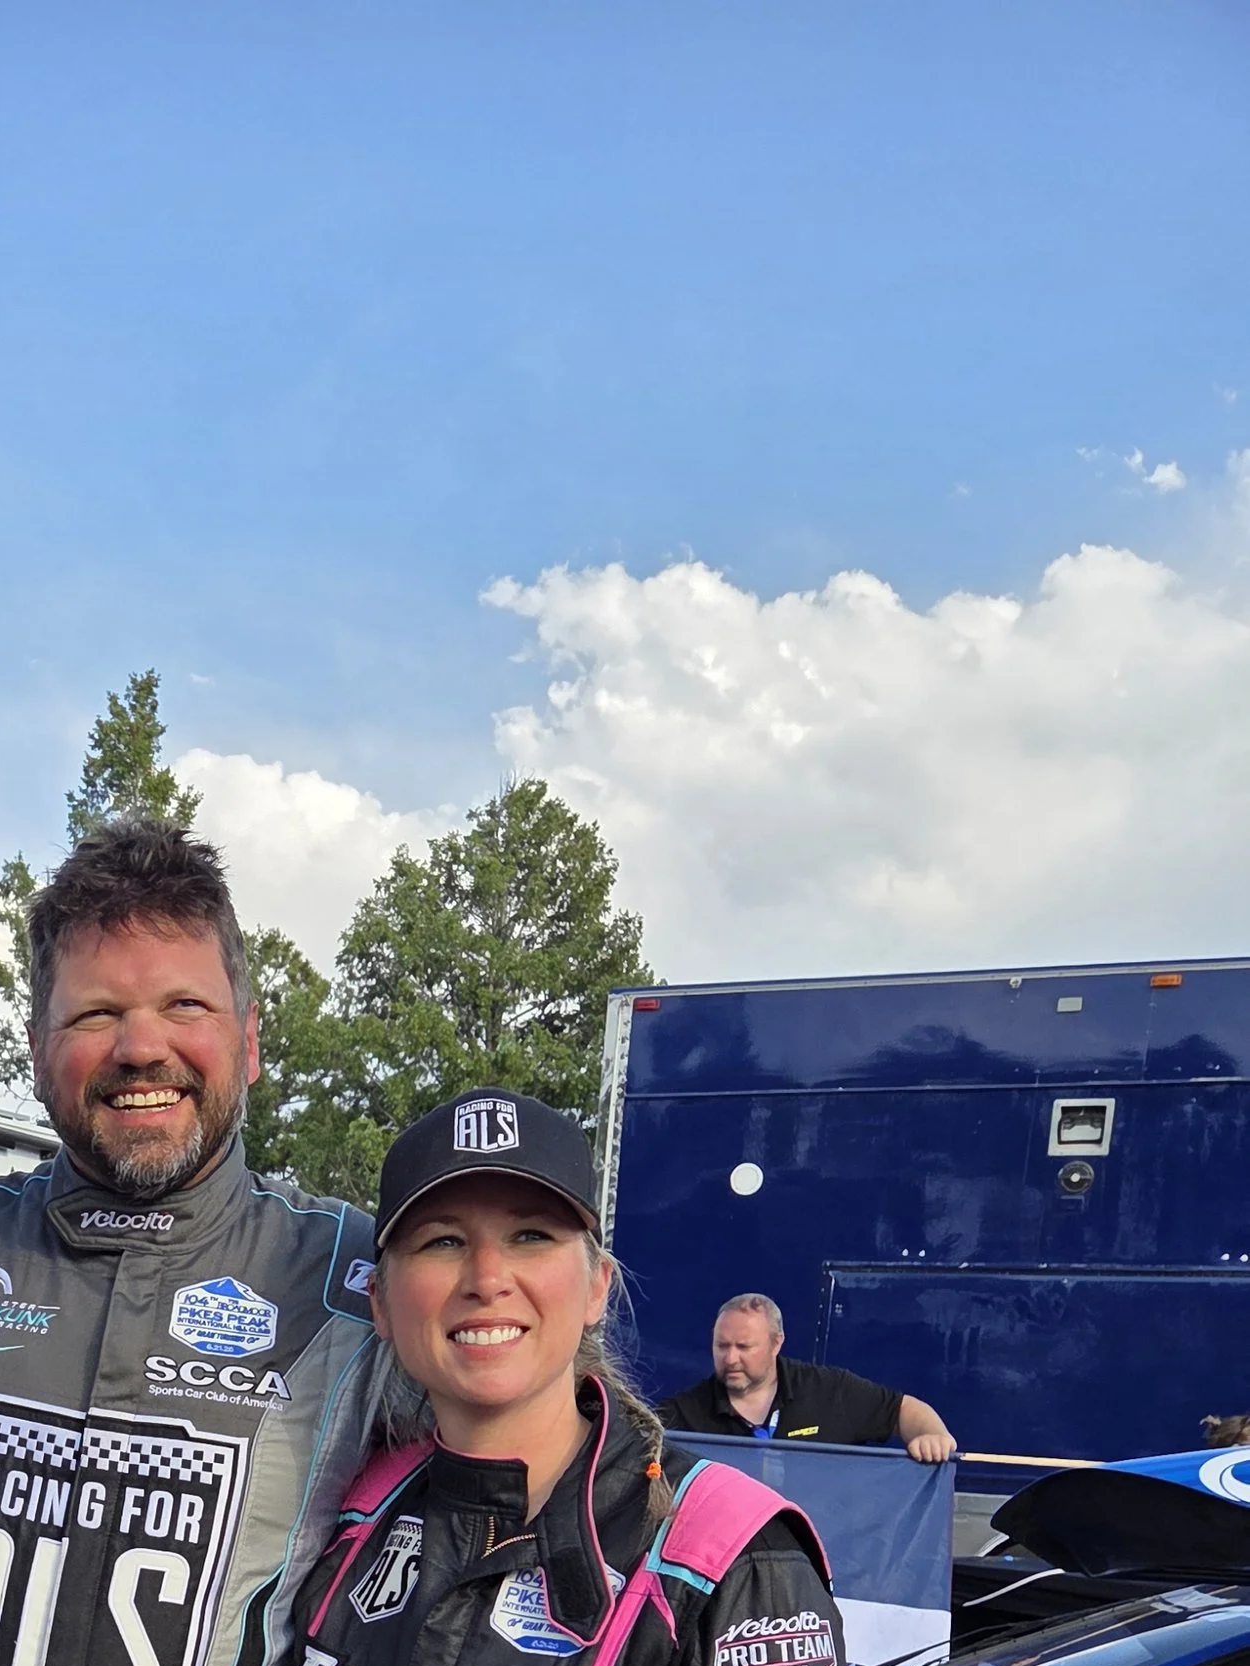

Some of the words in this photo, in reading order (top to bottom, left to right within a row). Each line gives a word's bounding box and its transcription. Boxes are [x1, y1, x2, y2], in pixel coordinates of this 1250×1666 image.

[459, 1111, 515, 1150] ALS
[80, 1210, 174, 1231] Velocita
[177, 1317, 232, 1330] INTERNATIONAL
[178, 1306, 223, 1322] PIKES
[227, 1313, 270, 1328] PEAK
[145, 1356, 292, 1400] SCCA
[148, 1384, 183, 1398] Sports
[184, 1388, 204, 1399] Car
[205, 1391, 228, 1403] Club
[229, 1395, 241, 1405] of
[243, 1397, 283, 1412] America
[119, 1486, 205, 1544] FOR
[356, 1549, 422, 1614] ALS
[502, 1600, 547, 1616] INTERNATI
[505, 1586, 546, 1606] PIKE
[775, 1634, 833, 1663] TEAM
